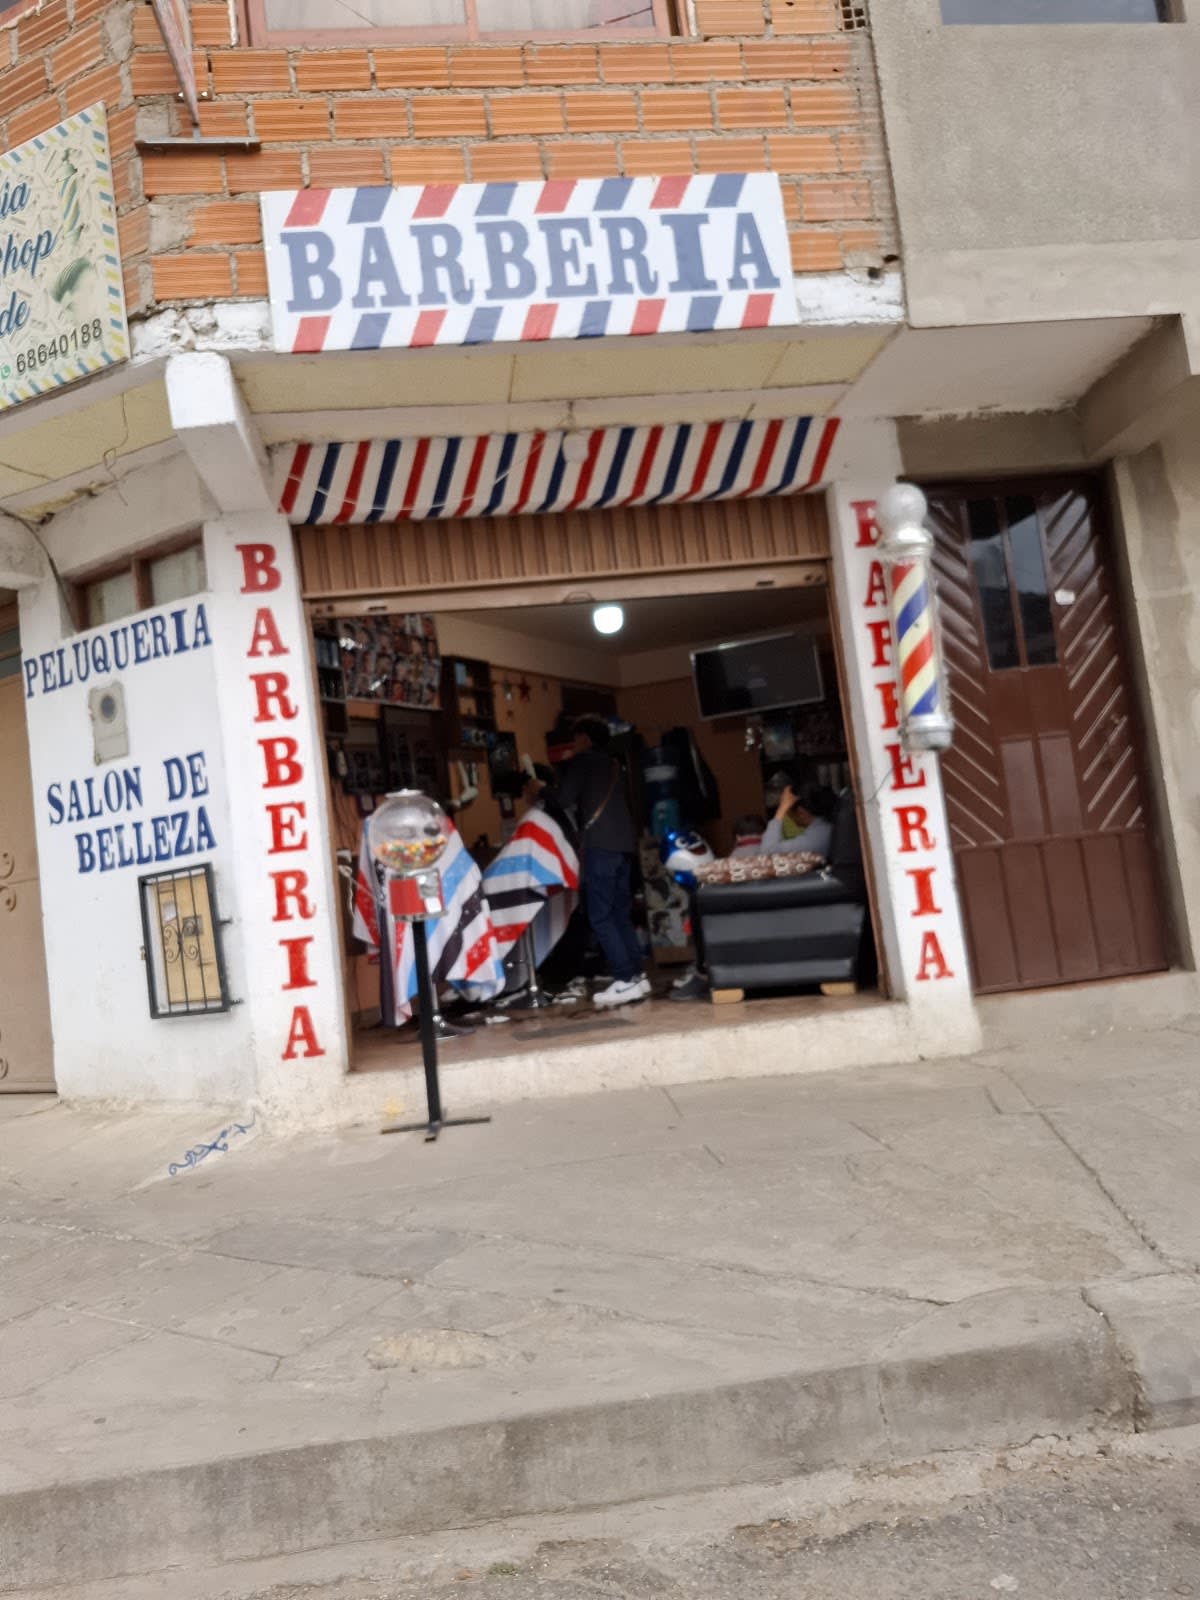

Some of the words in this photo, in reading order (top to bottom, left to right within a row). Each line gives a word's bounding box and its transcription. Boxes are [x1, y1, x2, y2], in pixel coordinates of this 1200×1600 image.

[0, 230, 57, 278] hop
[280, 212, 781, 313] BARBERIA
[16, 318, 102, 374] 68640188
[23, 603, 212, 698] PELUQUERIA
[47, 765, 143, 826] SALON
[163, 750, 209, 802] DE
[235, 541, 325, 1061] BARBERIA
[77, 804, 217, 874] BELLEZA
